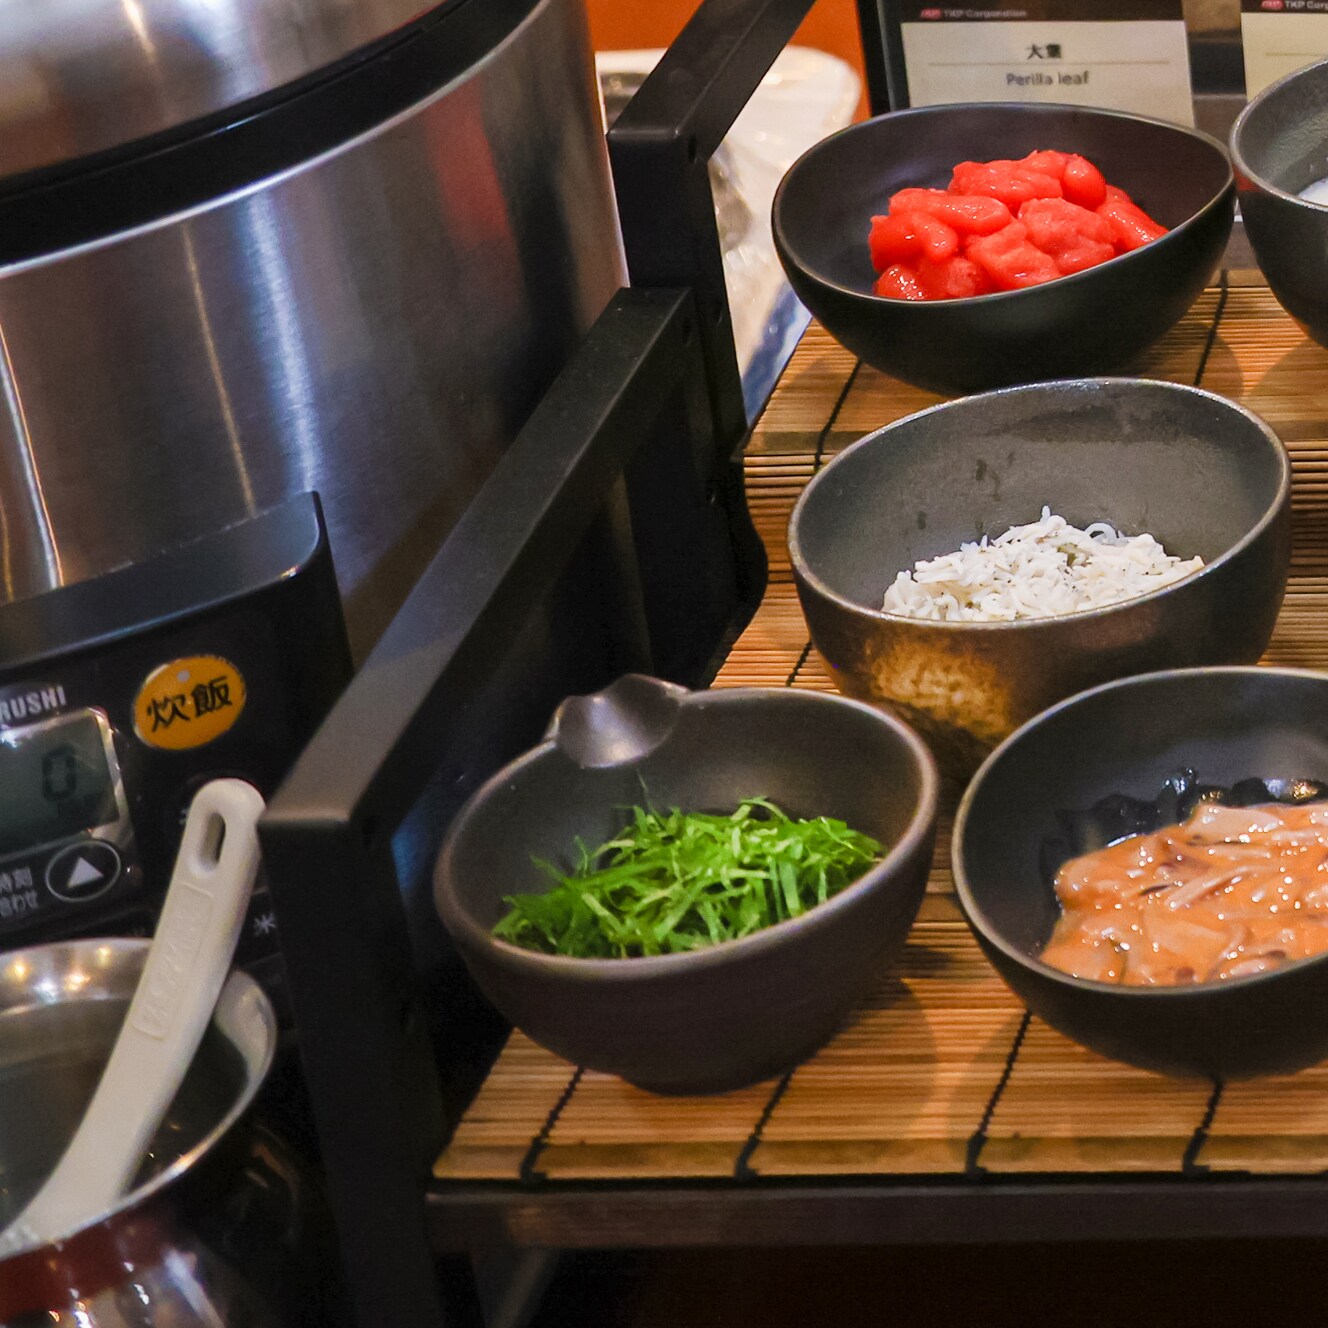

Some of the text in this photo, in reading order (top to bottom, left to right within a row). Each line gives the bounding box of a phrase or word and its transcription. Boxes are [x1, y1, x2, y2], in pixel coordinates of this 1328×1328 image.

[1006, 70, 1089, 86] Perilla leaf
[147, 676, 233, 732] 炊飯
